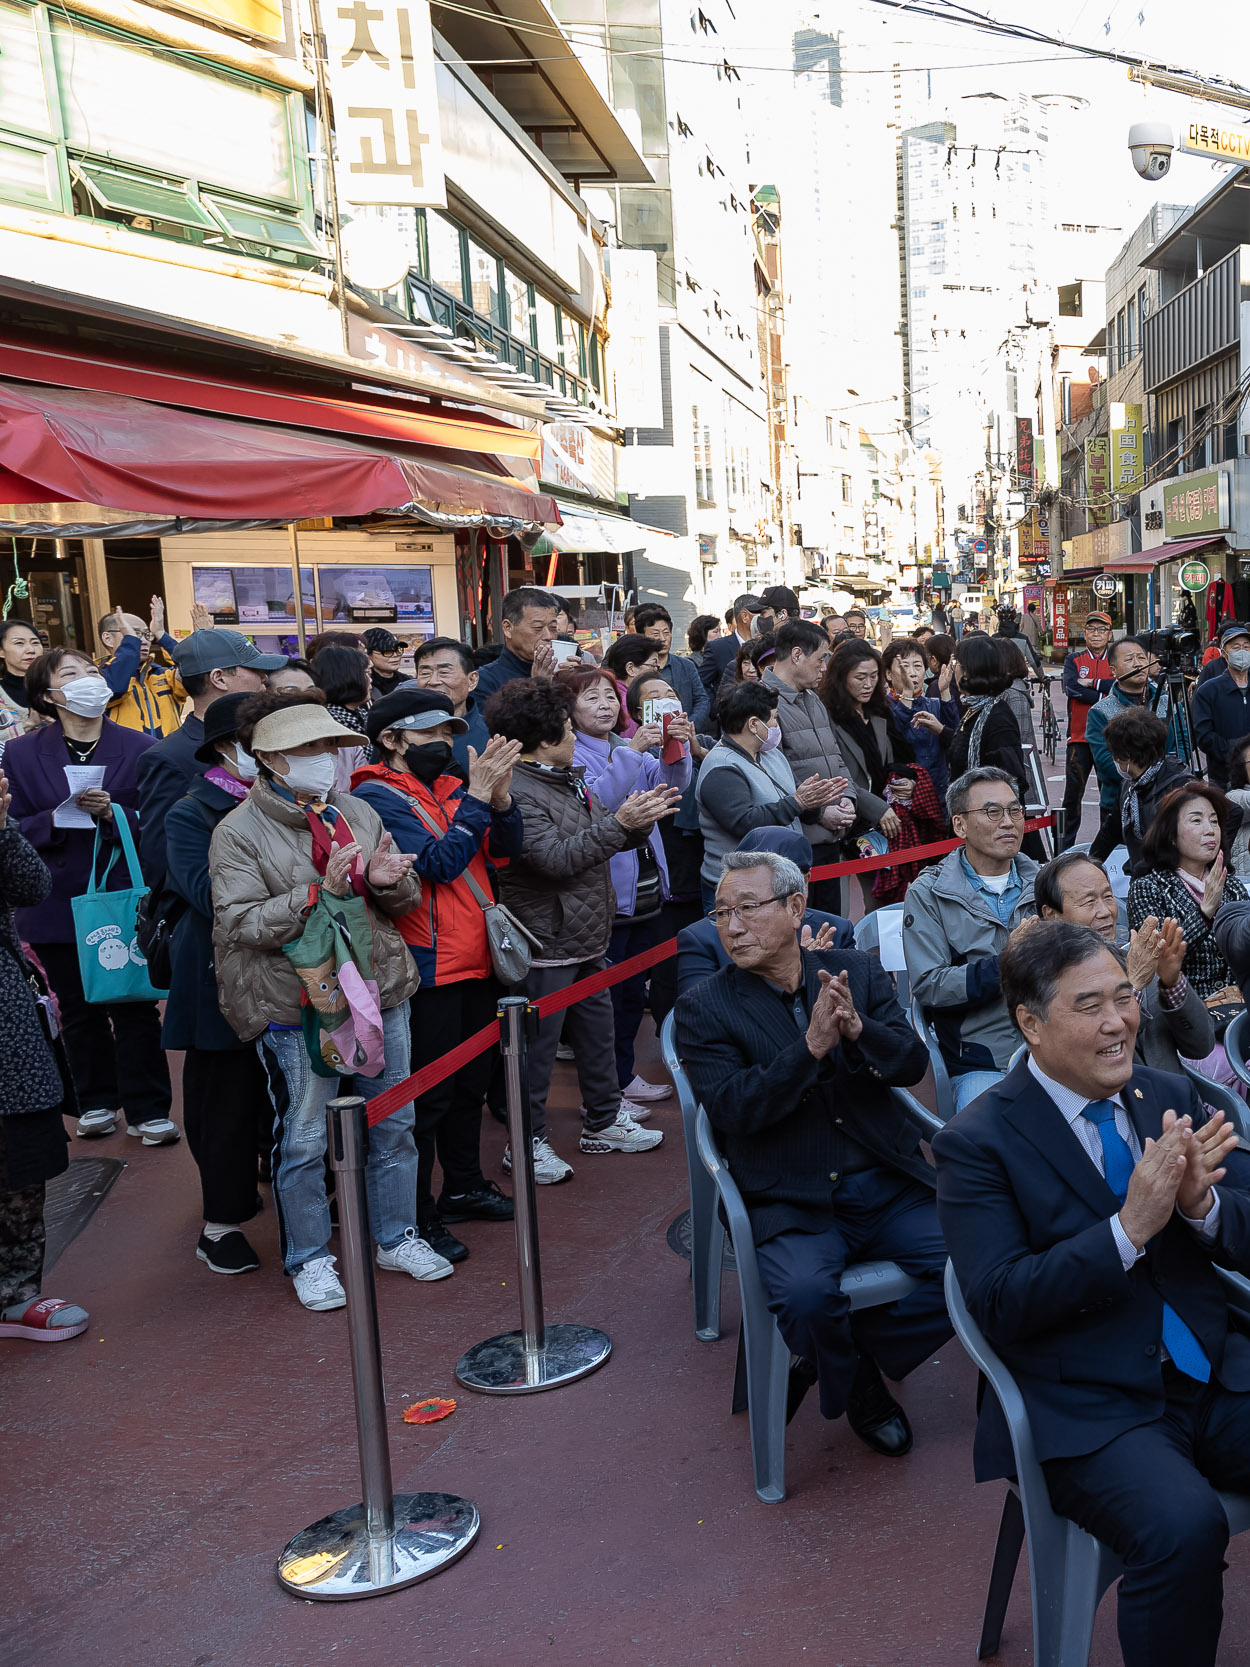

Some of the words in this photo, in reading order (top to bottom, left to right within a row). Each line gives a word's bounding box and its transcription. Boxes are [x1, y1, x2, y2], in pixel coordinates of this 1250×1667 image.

[337, 1, 430, 188] 치과
[1118, 416, 1138, 484] 中国食品
[1096, 580, 1114, 590] 커피
[1183, 573, 1206, 584] 카페
[1055, 592, 1066, 640] 中国食品
